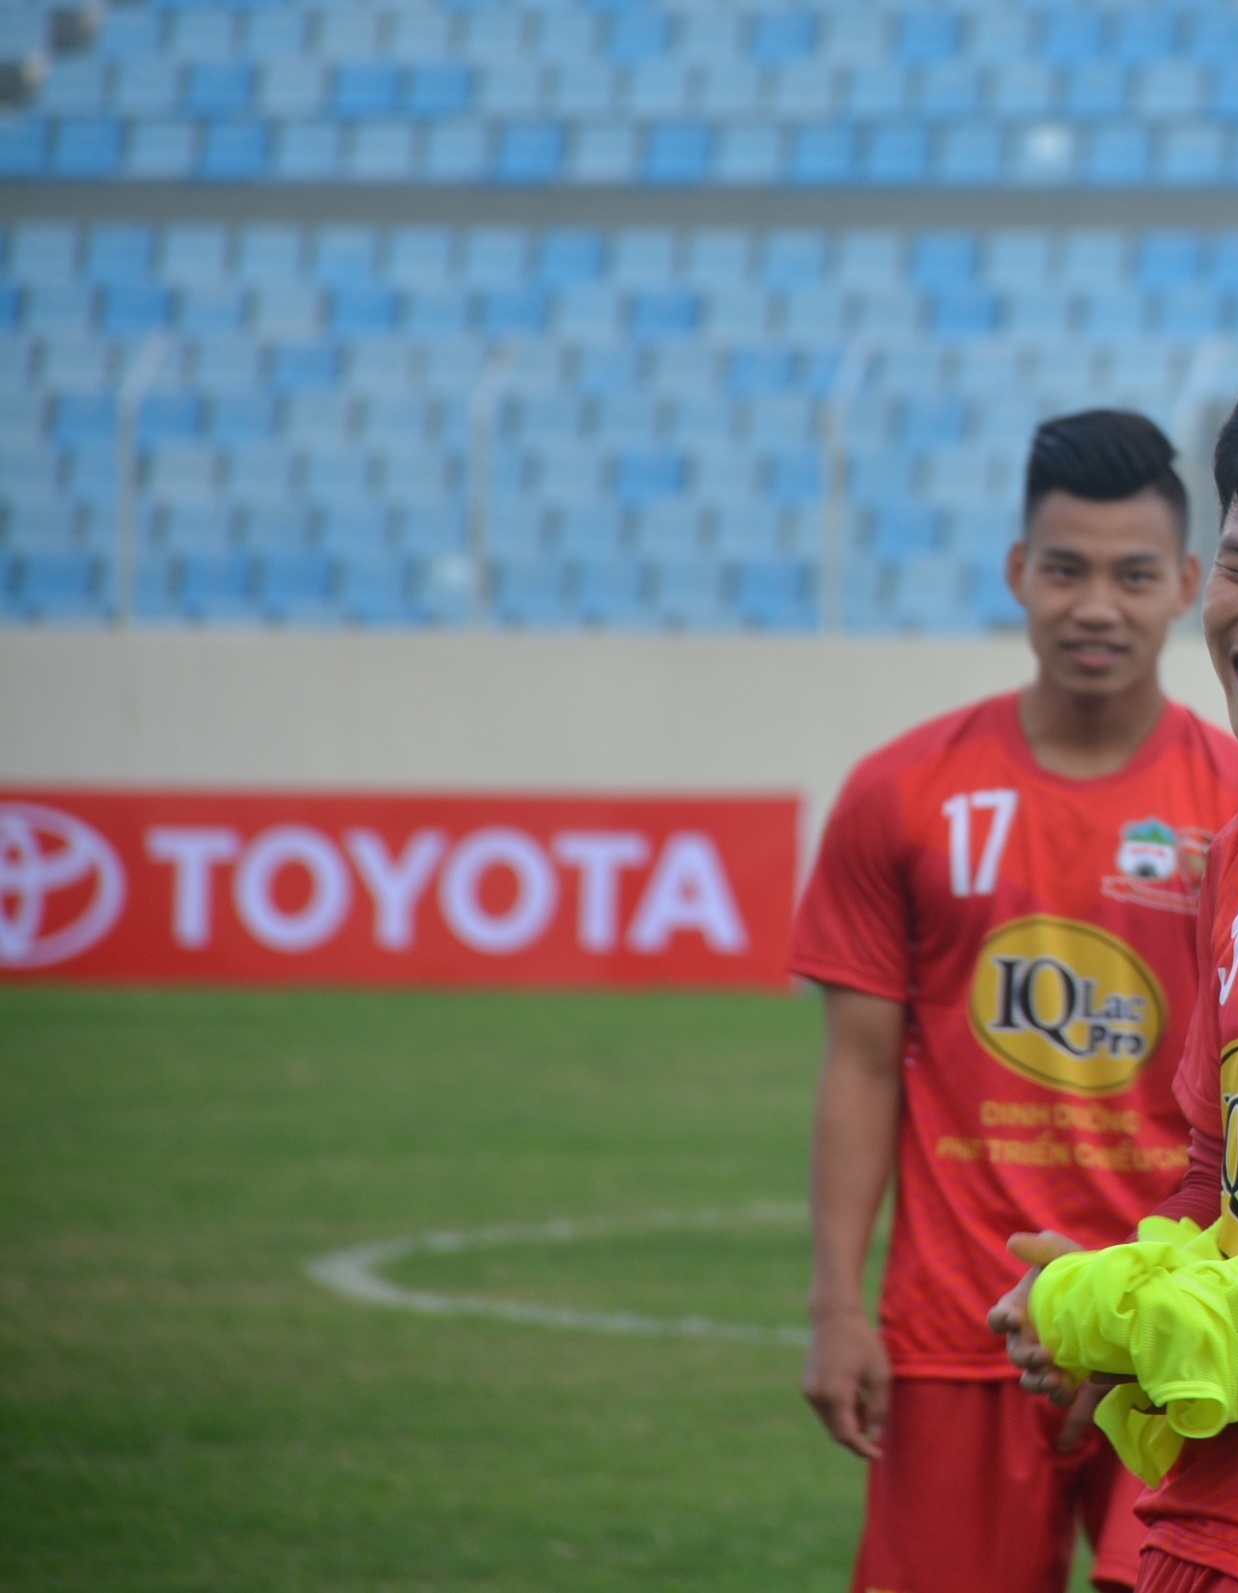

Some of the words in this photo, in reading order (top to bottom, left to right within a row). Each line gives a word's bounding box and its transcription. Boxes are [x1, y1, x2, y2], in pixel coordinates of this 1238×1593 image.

[144, 823, 749, 954] TOYOTA
[942, 787, 1019, 897] 17
[990, 956, 1088, 1057] IQ
[1080, 978, 1146, 1021] Lac
[1090, 1023, 1146, 1057] Pro
